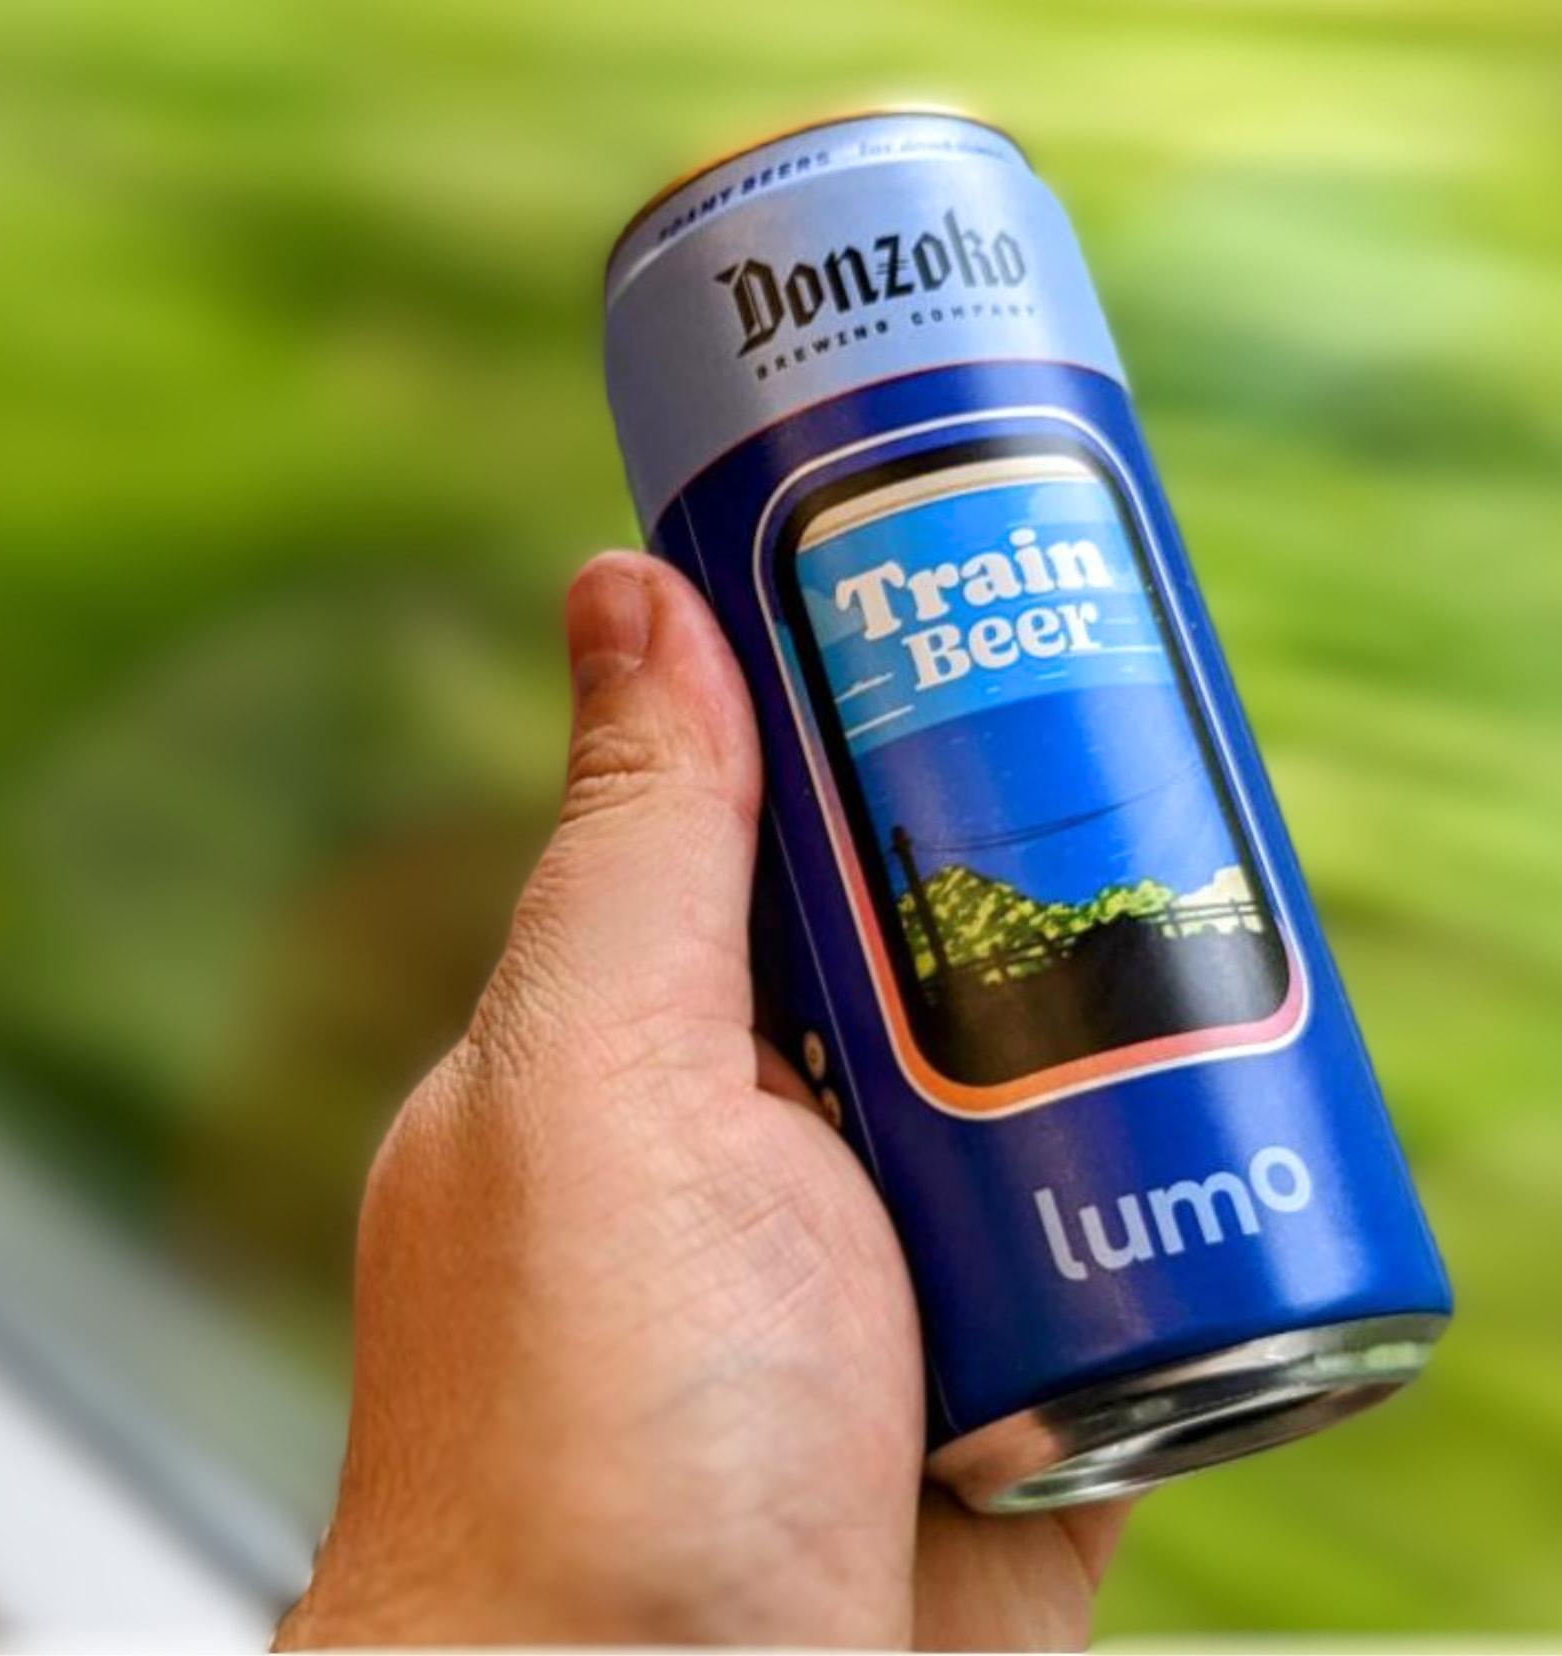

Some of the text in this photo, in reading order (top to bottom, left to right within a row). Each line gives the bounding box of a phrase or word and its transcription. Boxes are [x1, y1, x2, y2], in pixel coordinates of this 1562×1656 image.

[741, 151, 830, 195] BEERS
[714, 207, 1027, 360] Donzoko
[756, 302, 1036, 381] BREWING COMPANY
[838, 528, 1113, 641] Train
[901, 602, 1103, 691] Beer
[1034, 1146, 1312, 1281] lumo
